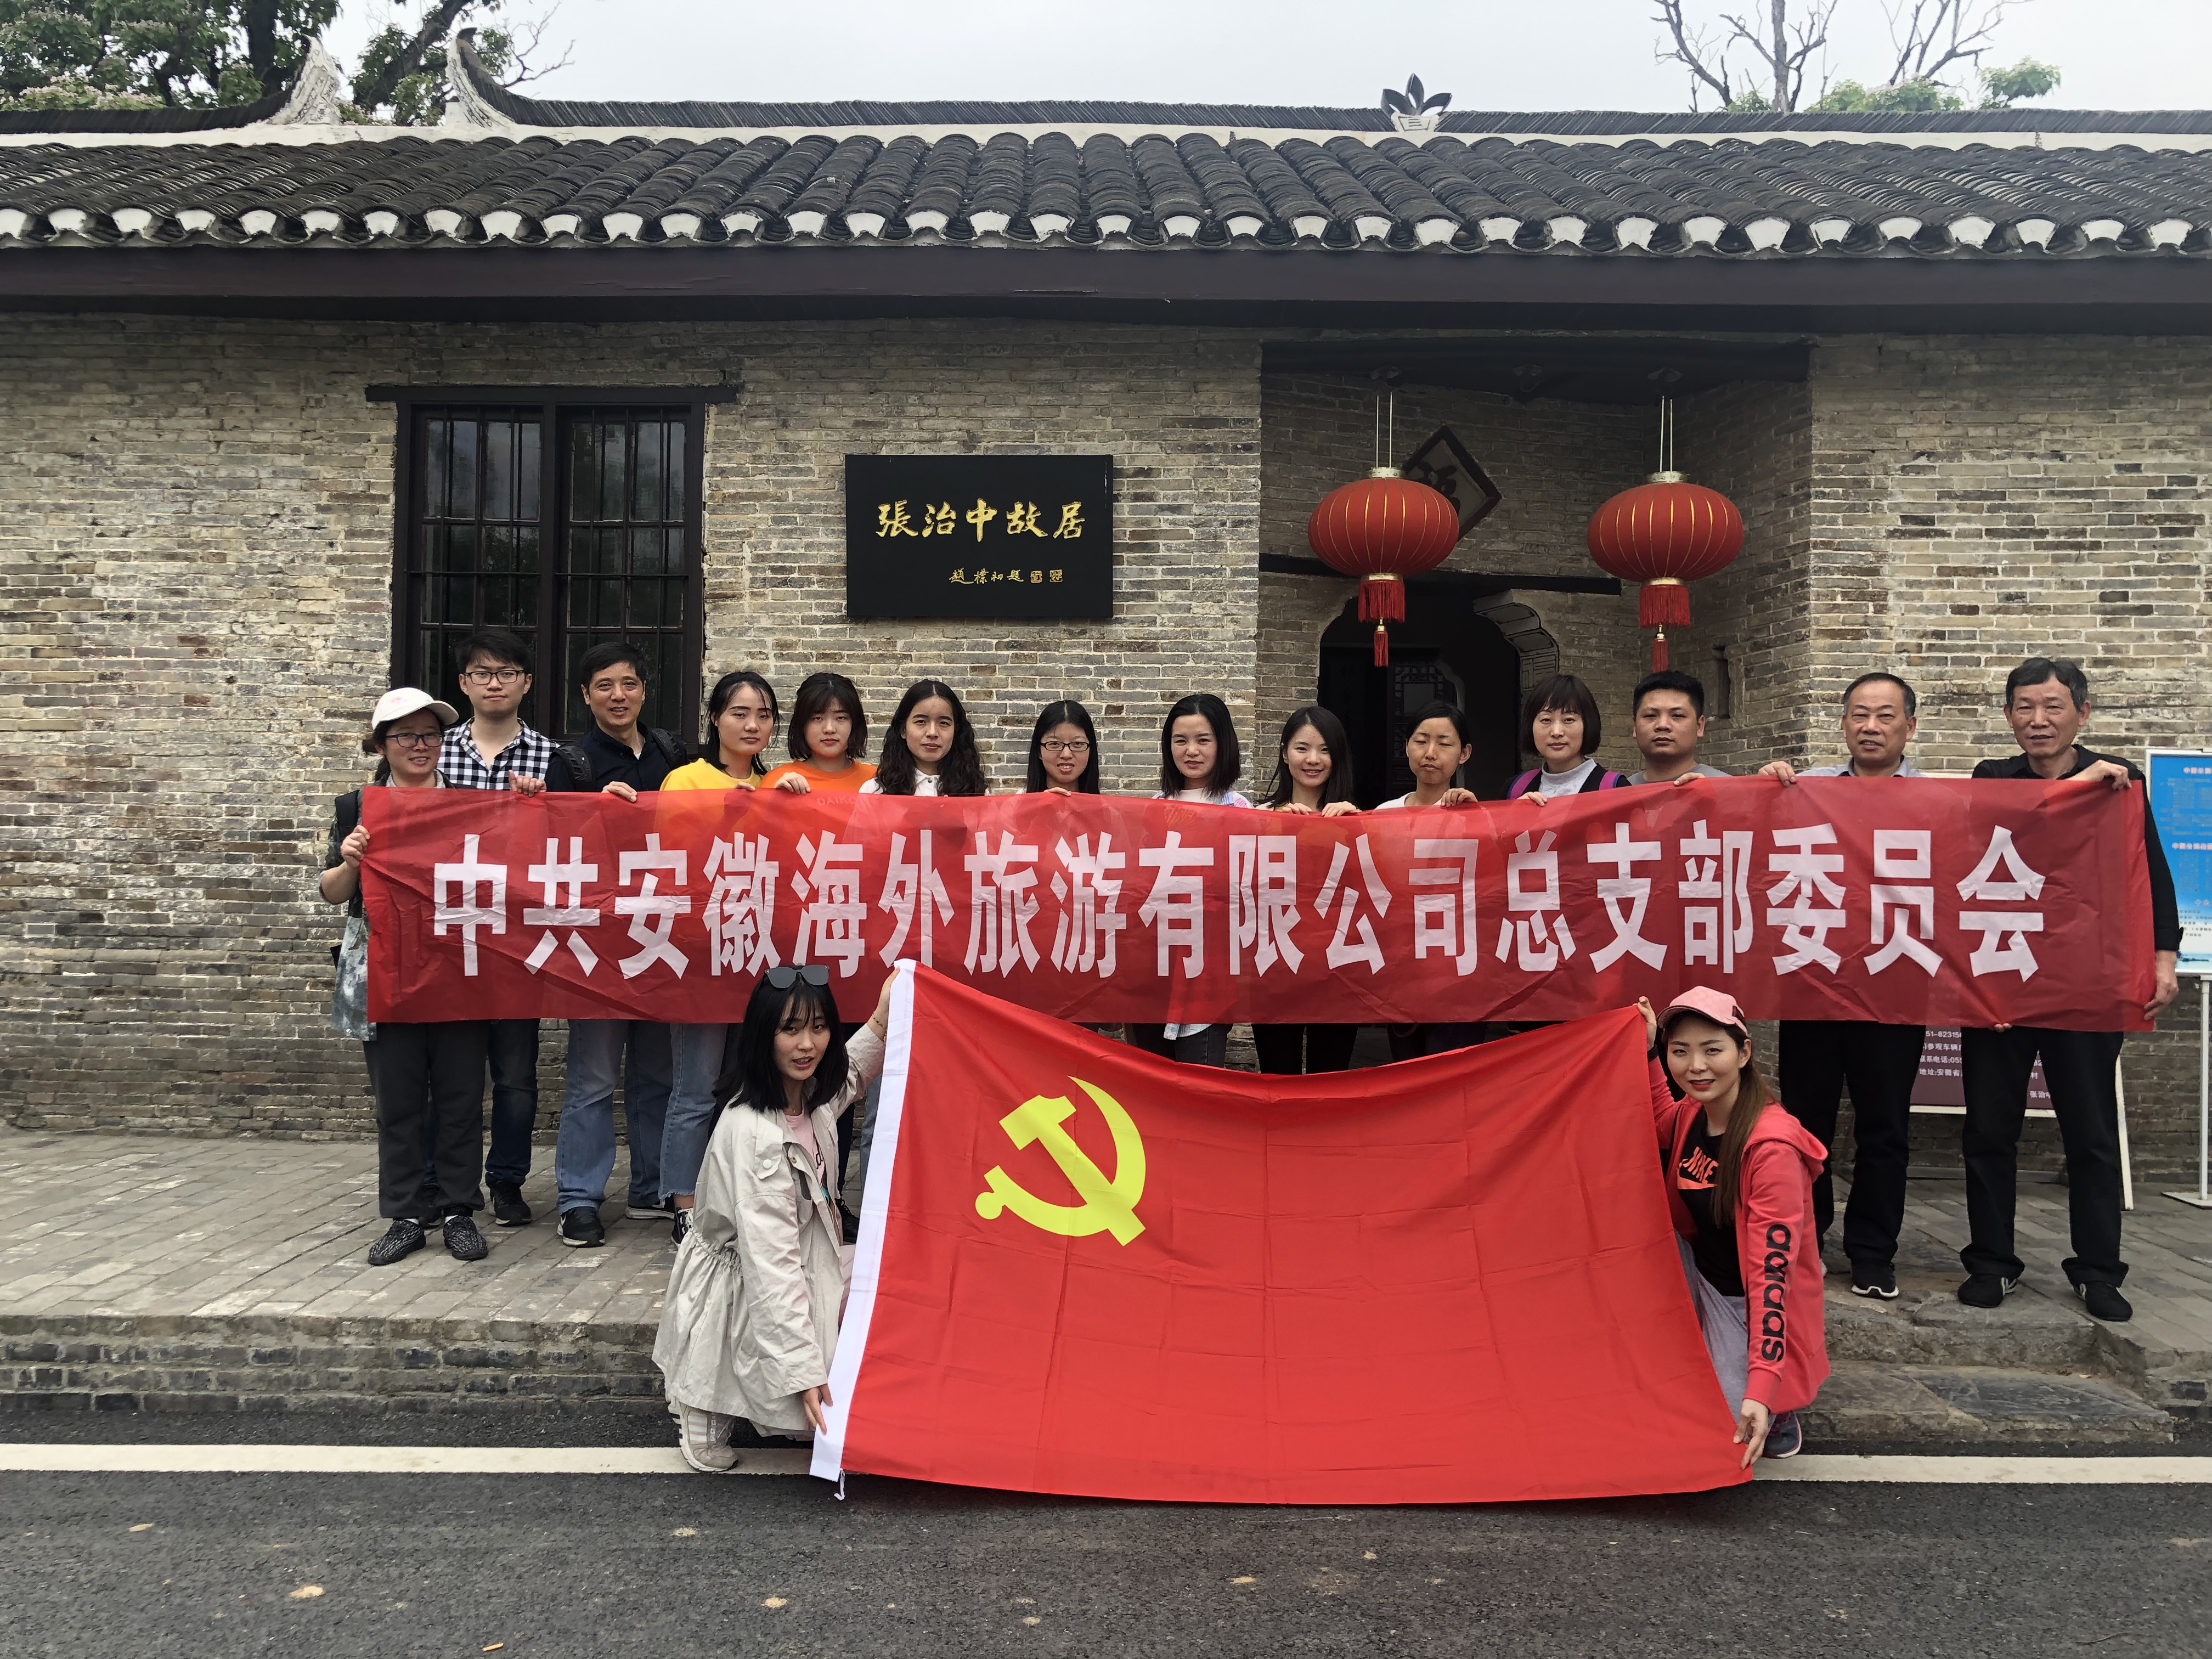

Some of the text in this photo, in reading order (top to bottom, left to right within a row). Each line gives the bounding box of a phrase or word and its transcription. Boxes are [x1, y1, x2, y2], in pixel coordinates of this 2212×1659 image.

[876, 498, 1085, 543] 張治中故居
[433, 819, 2046, 983] 中共安徽海外旅游有限公司总支部委员会
[1682, 1146, 1720, 1184] NIKE
[1761, 1223, 1791, 1362] adidas
